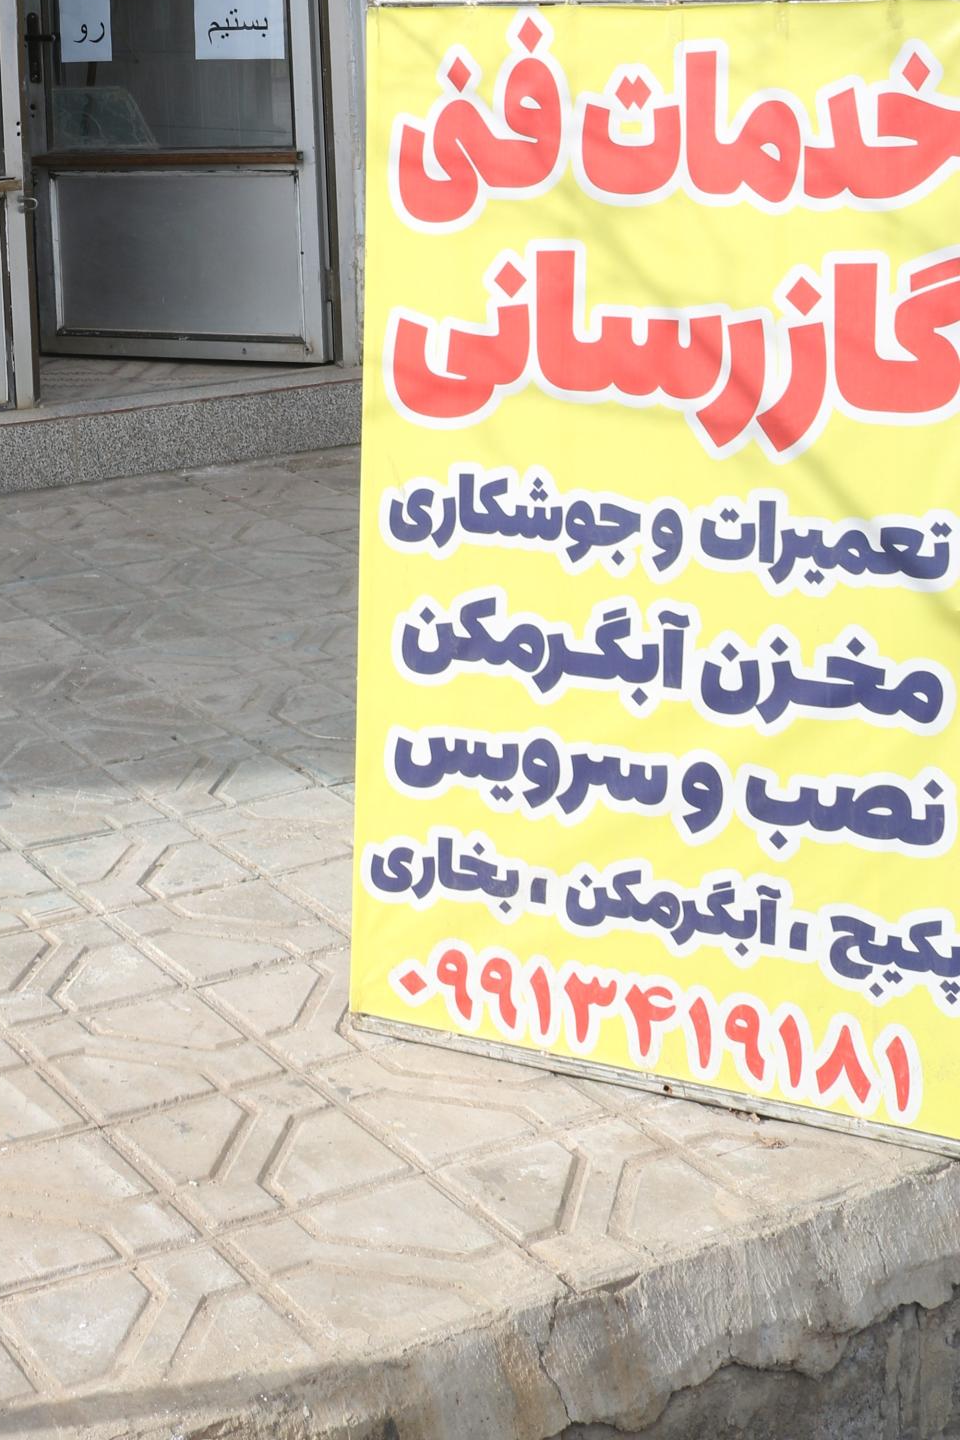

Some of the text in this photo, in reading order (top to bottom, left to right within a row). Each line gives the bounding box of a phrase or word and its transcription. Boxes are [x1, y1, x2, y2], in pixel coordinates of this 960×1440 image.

[73, 17, 106, 44] رو
[206, 8, 270, 44] بستیم
[398, 16, 960, 223] خدمات فنی
[388, 473, 953, 584] تعمیرات و جوشکاری
[400, 596, 945, 725] مخزن آبگرمکن
[393, 735, 946, 850] نصب و سرویس
[369, 836, 520, 914] بخاری
[564, 868, 782, 957] آبگرمکن
[397, 948, 912, 1113] ۰۹۹۱۳۴۱۹۱۸۱
